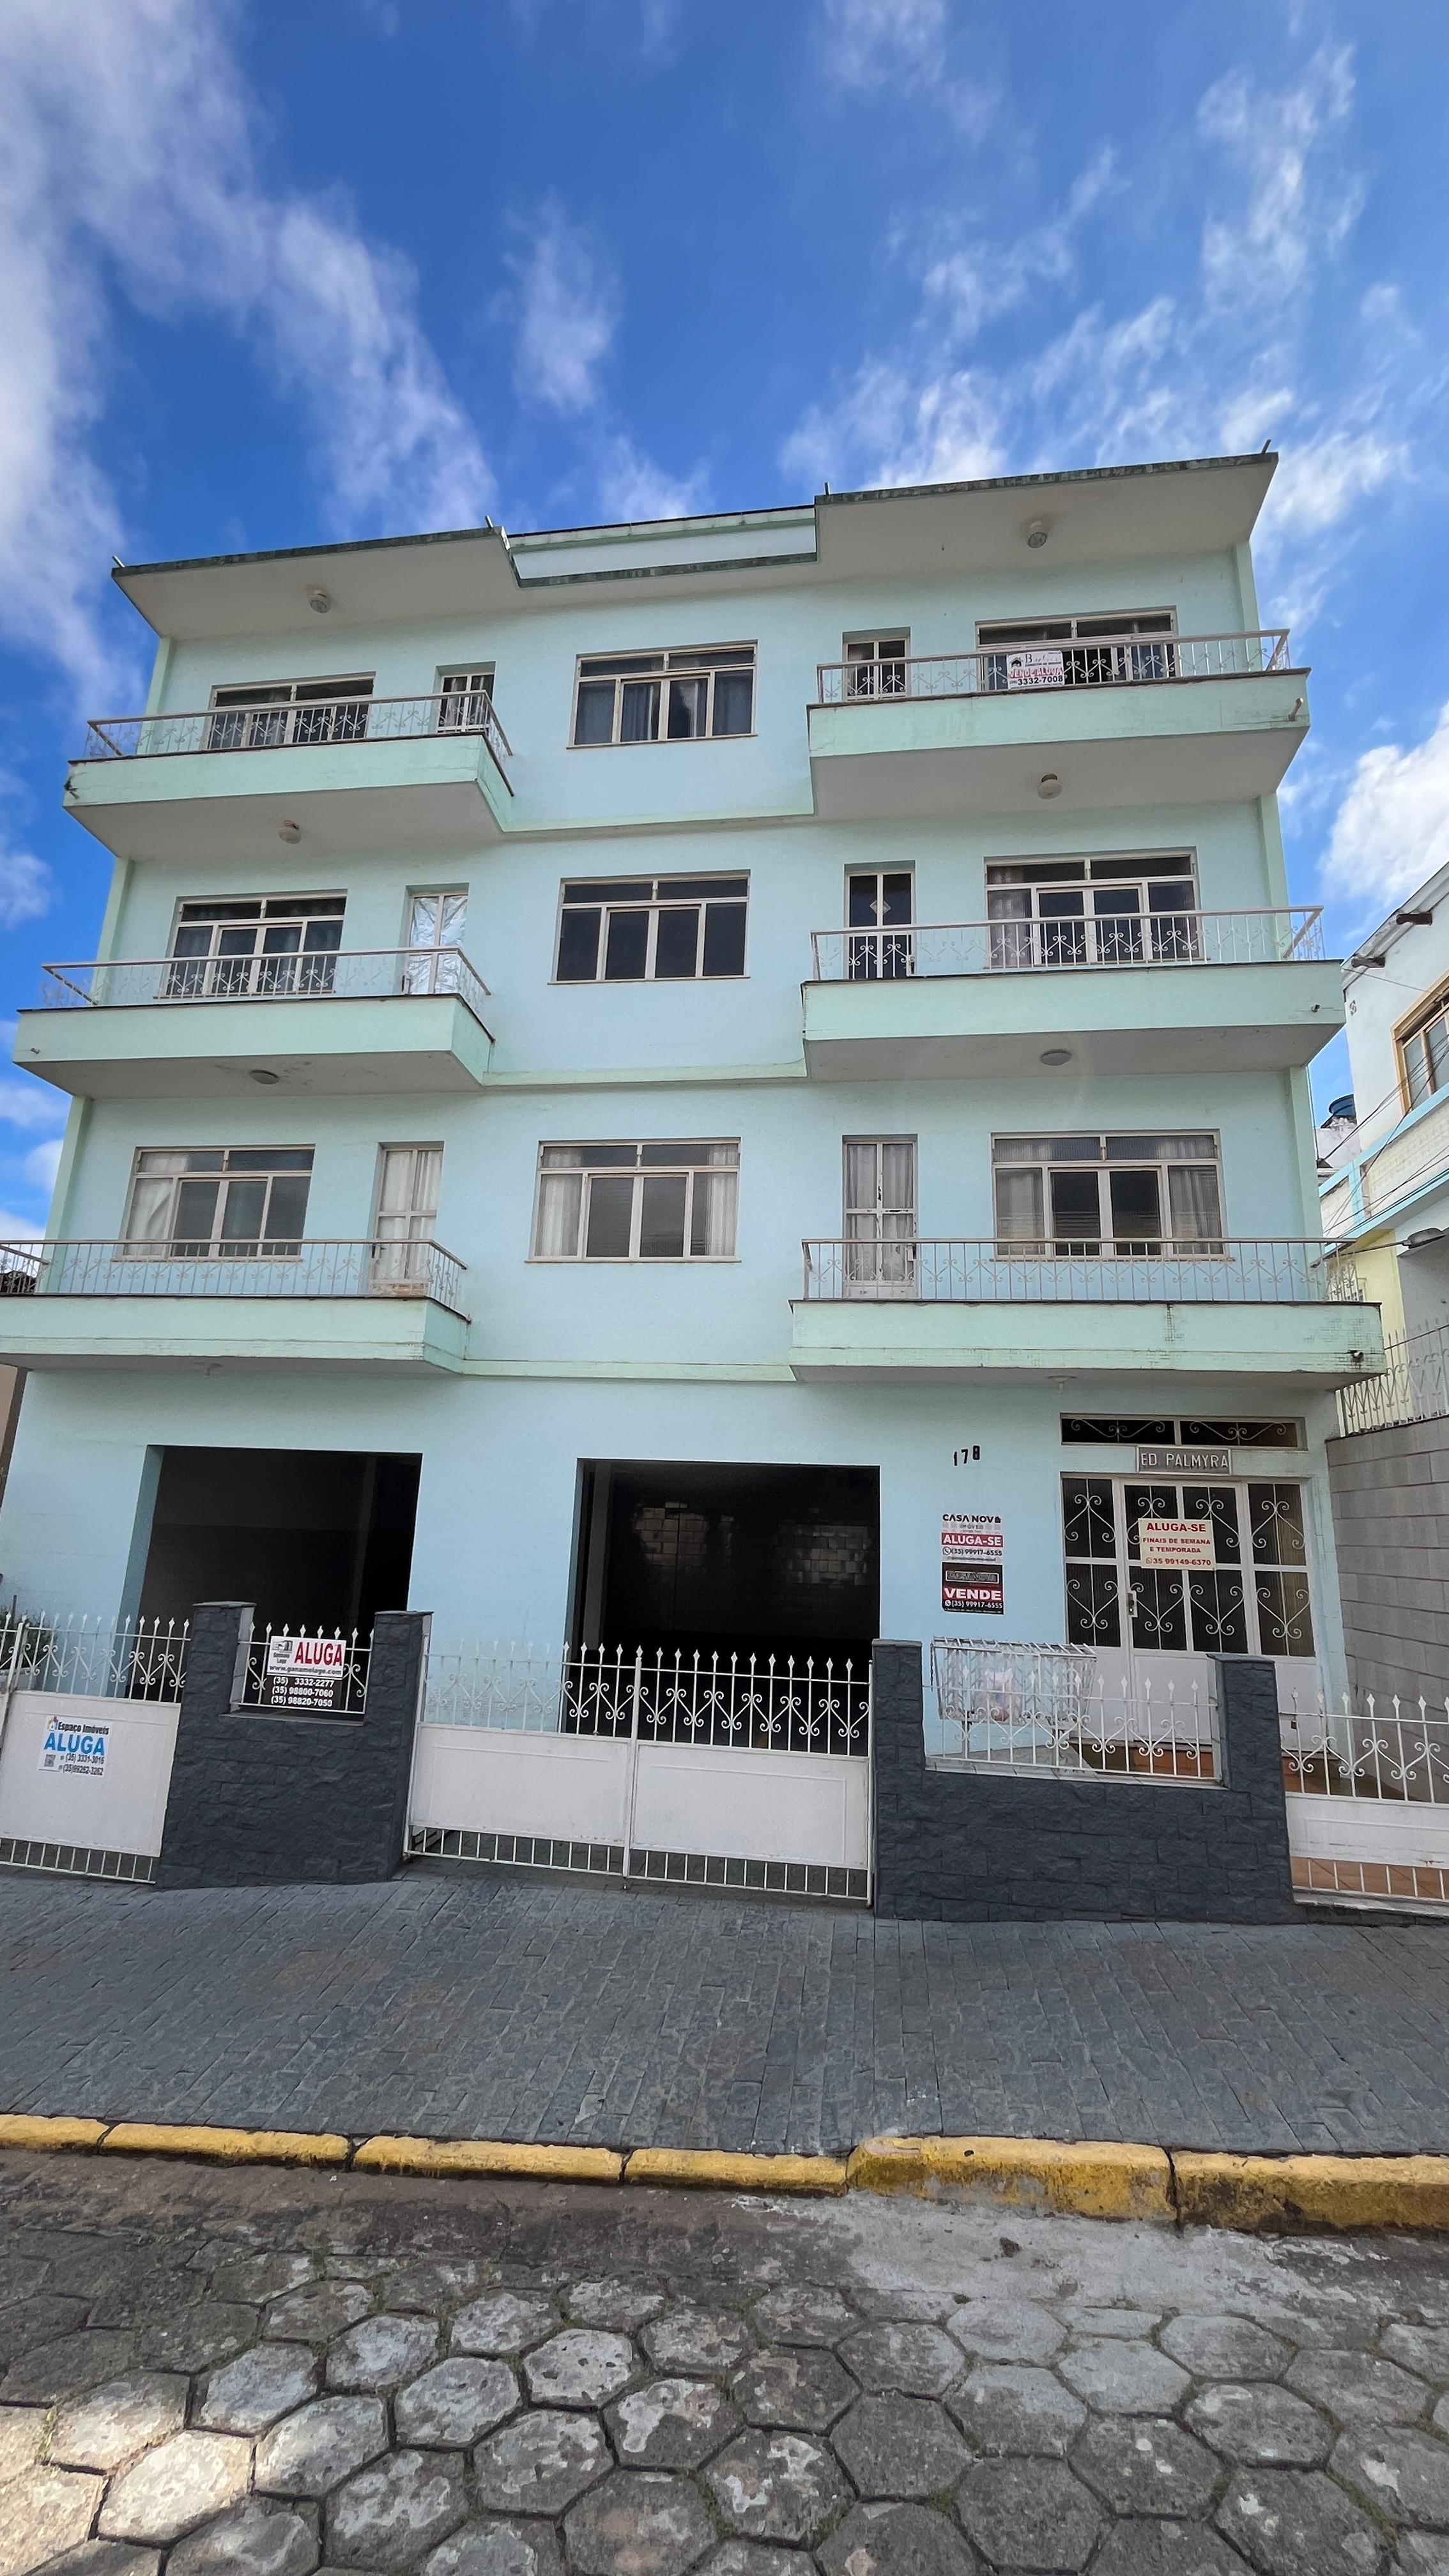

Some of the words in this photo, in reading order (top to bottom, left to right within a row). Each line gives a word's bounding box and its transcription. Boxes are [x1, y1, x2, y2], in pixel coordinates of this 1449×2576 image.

[1018, 675, 1063, 686] 3332-7008
[953, 1445, 980, 1466] 178
[1140, 1453, 1157, 1466] ED
[1166, 1453, 1229, 1468] PALMYRA
[942, 1514, 969, 1522] CASA
[1146, 1522, 1206, 1532] ALUGA-SE
[943, 1534, 1002, 1546] ALUGA-SE
[944, 1588, 1002, 1600] VENDE
[295, 1641, 342, 1666] ALUGA
[273, 1676, 289, 1686] (35)
[294, 1678, 335, 1688] 3332-2277
[272, 1685, 288, 1696] (35)
[271, 1696, 286, 1705] (35)
[58, 1721, 82, 1734] Espaço
[82, 1724, 109, 1735] Imóveis
[43, 1732, 105, 1756] ALUGA
